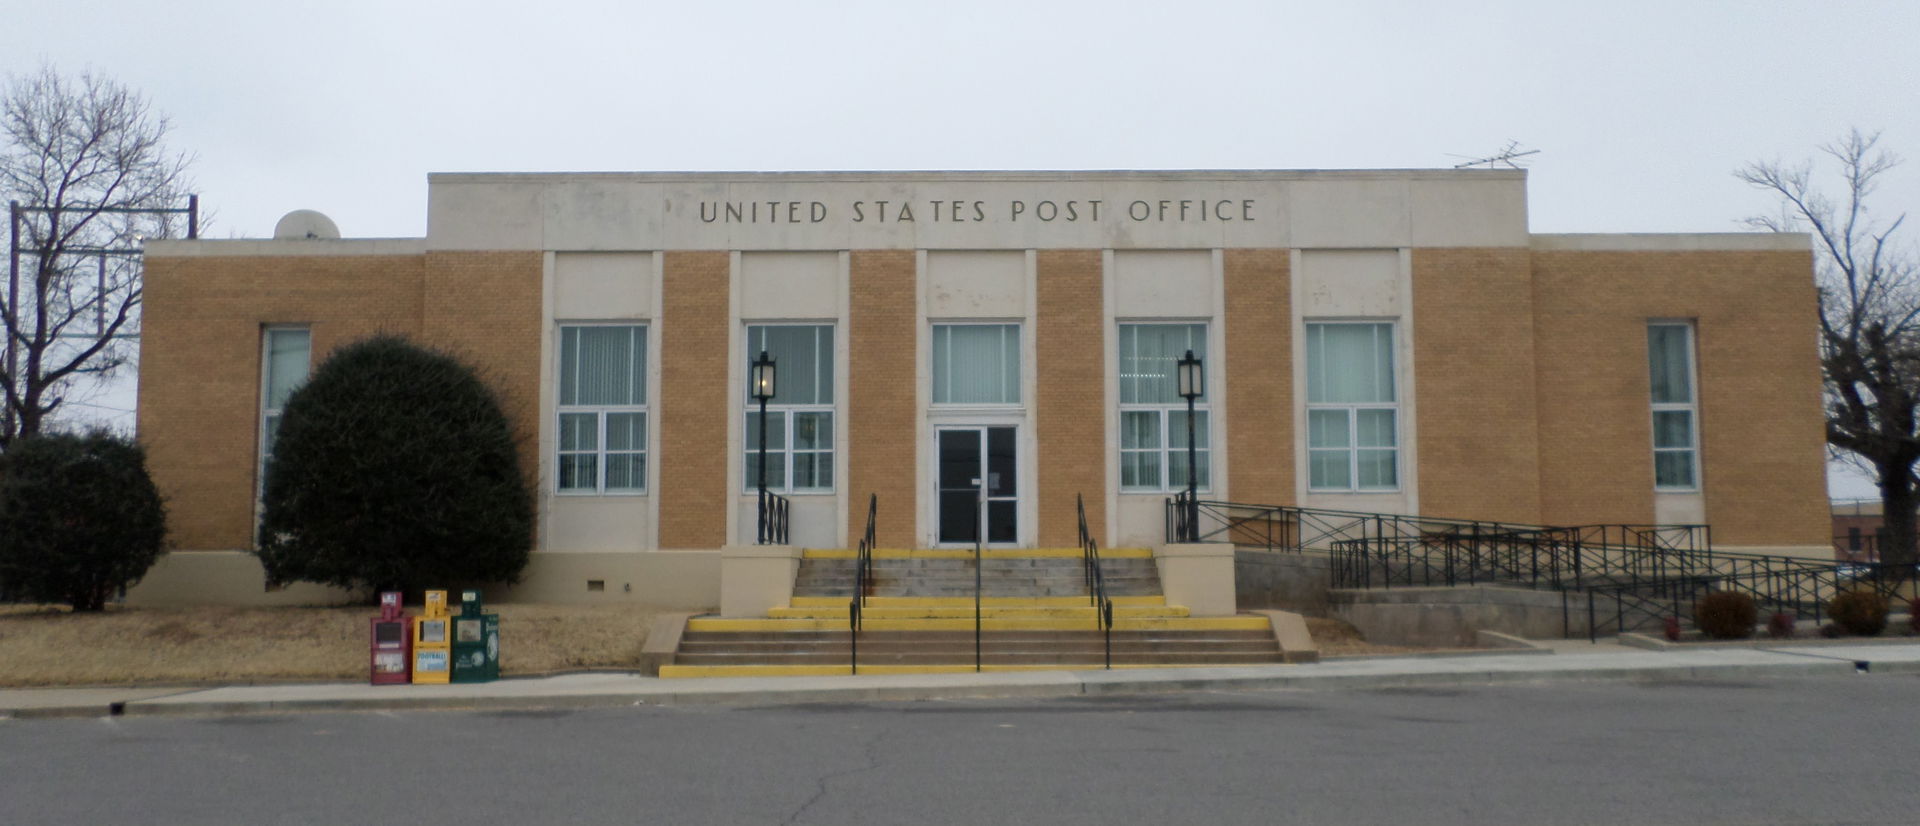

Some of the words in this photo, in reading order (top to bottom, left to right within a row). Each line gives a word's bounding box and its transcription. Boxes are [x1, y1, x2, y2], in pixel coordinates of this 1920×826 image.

[700, 201, 827, 223] UNITED
[852, 200, 985, 223] STATES
[1011, 200, 1103, 222] POST
[1128, 199, 1256, 222] OFFICE
